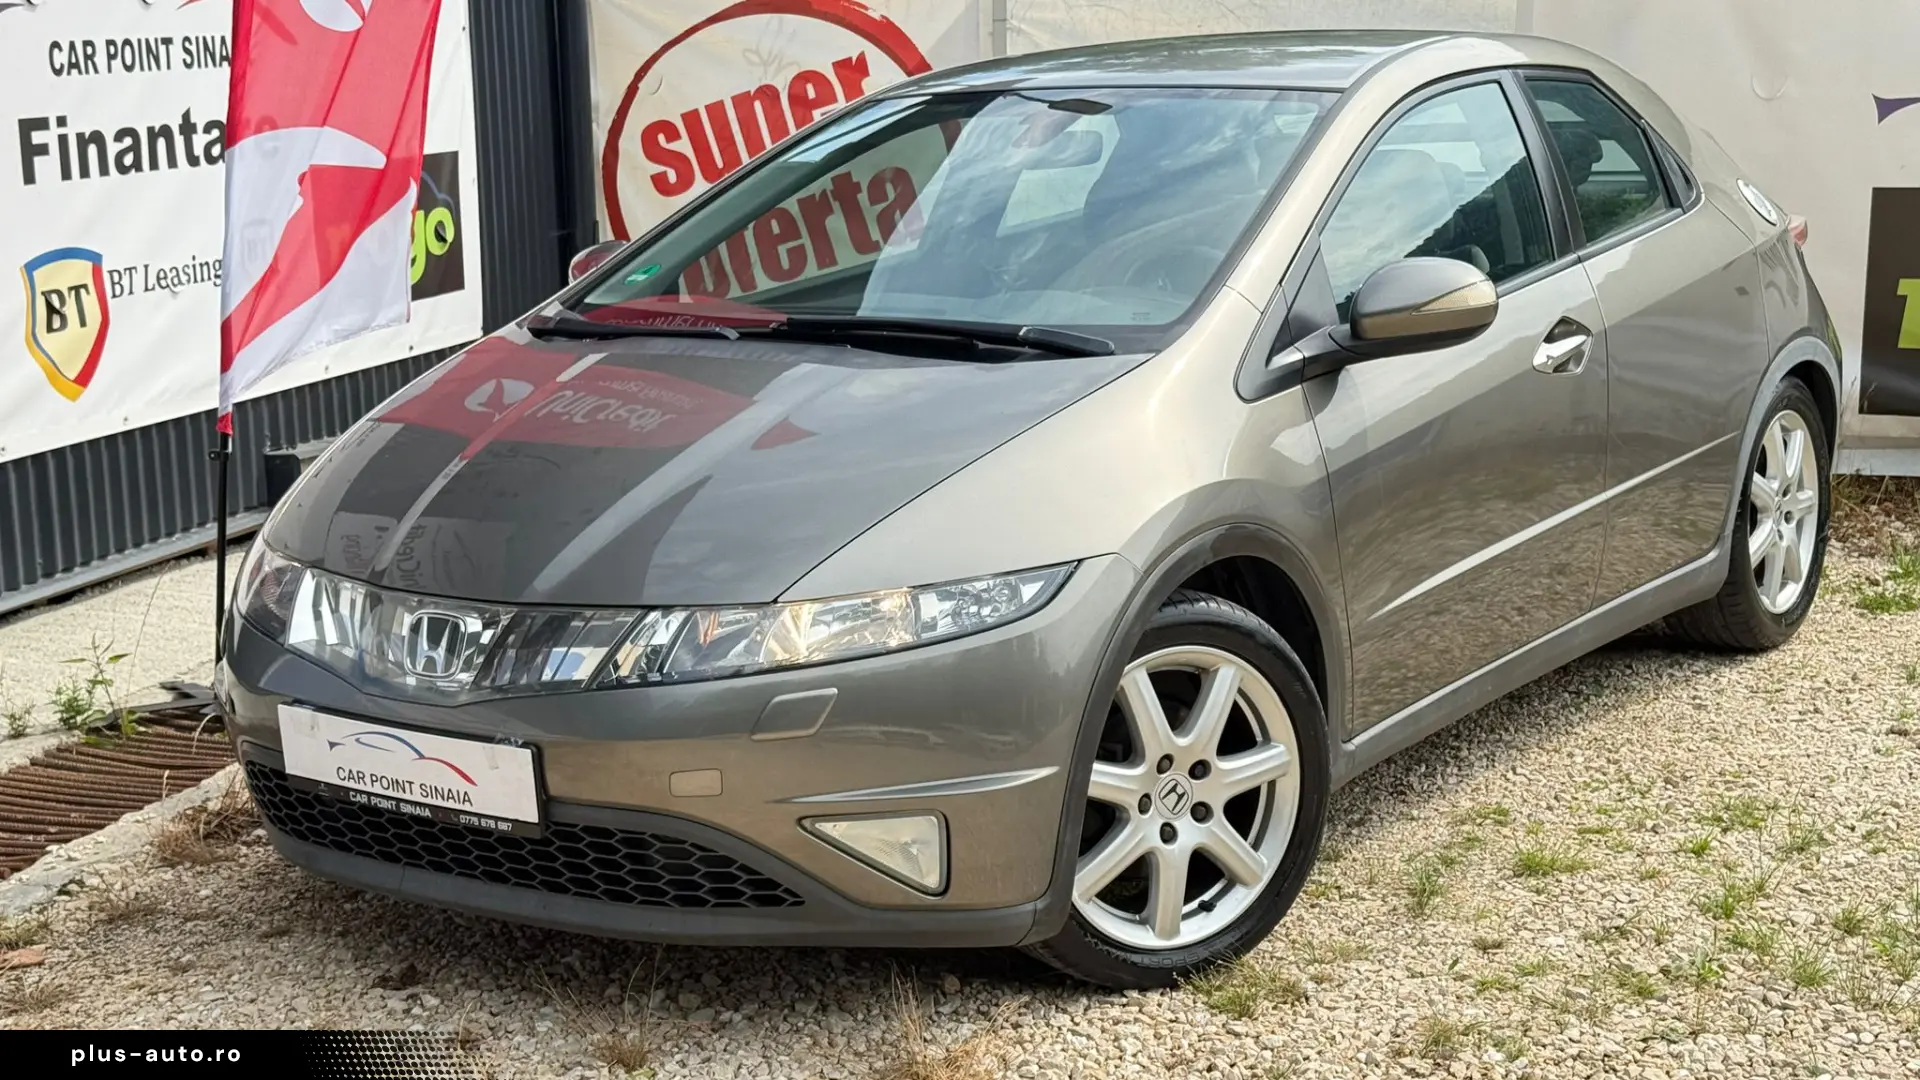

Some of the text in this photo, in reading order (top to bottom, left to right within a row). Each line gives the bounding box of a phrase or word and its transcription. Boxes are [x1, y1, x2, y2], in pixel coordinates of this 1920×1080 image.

[48, 35, 232, 77] CAR POINT SINA
[107, 256, 223, 300] BT Leasing
[41, 283, 91, 334] BT
[336, 766, 473, 808] CAR POINT SINAIA
[349, 791, 368, 806] CAR
[371, 795, 397, 811] POINT
[400, 802, 431, 818] SINAIA
